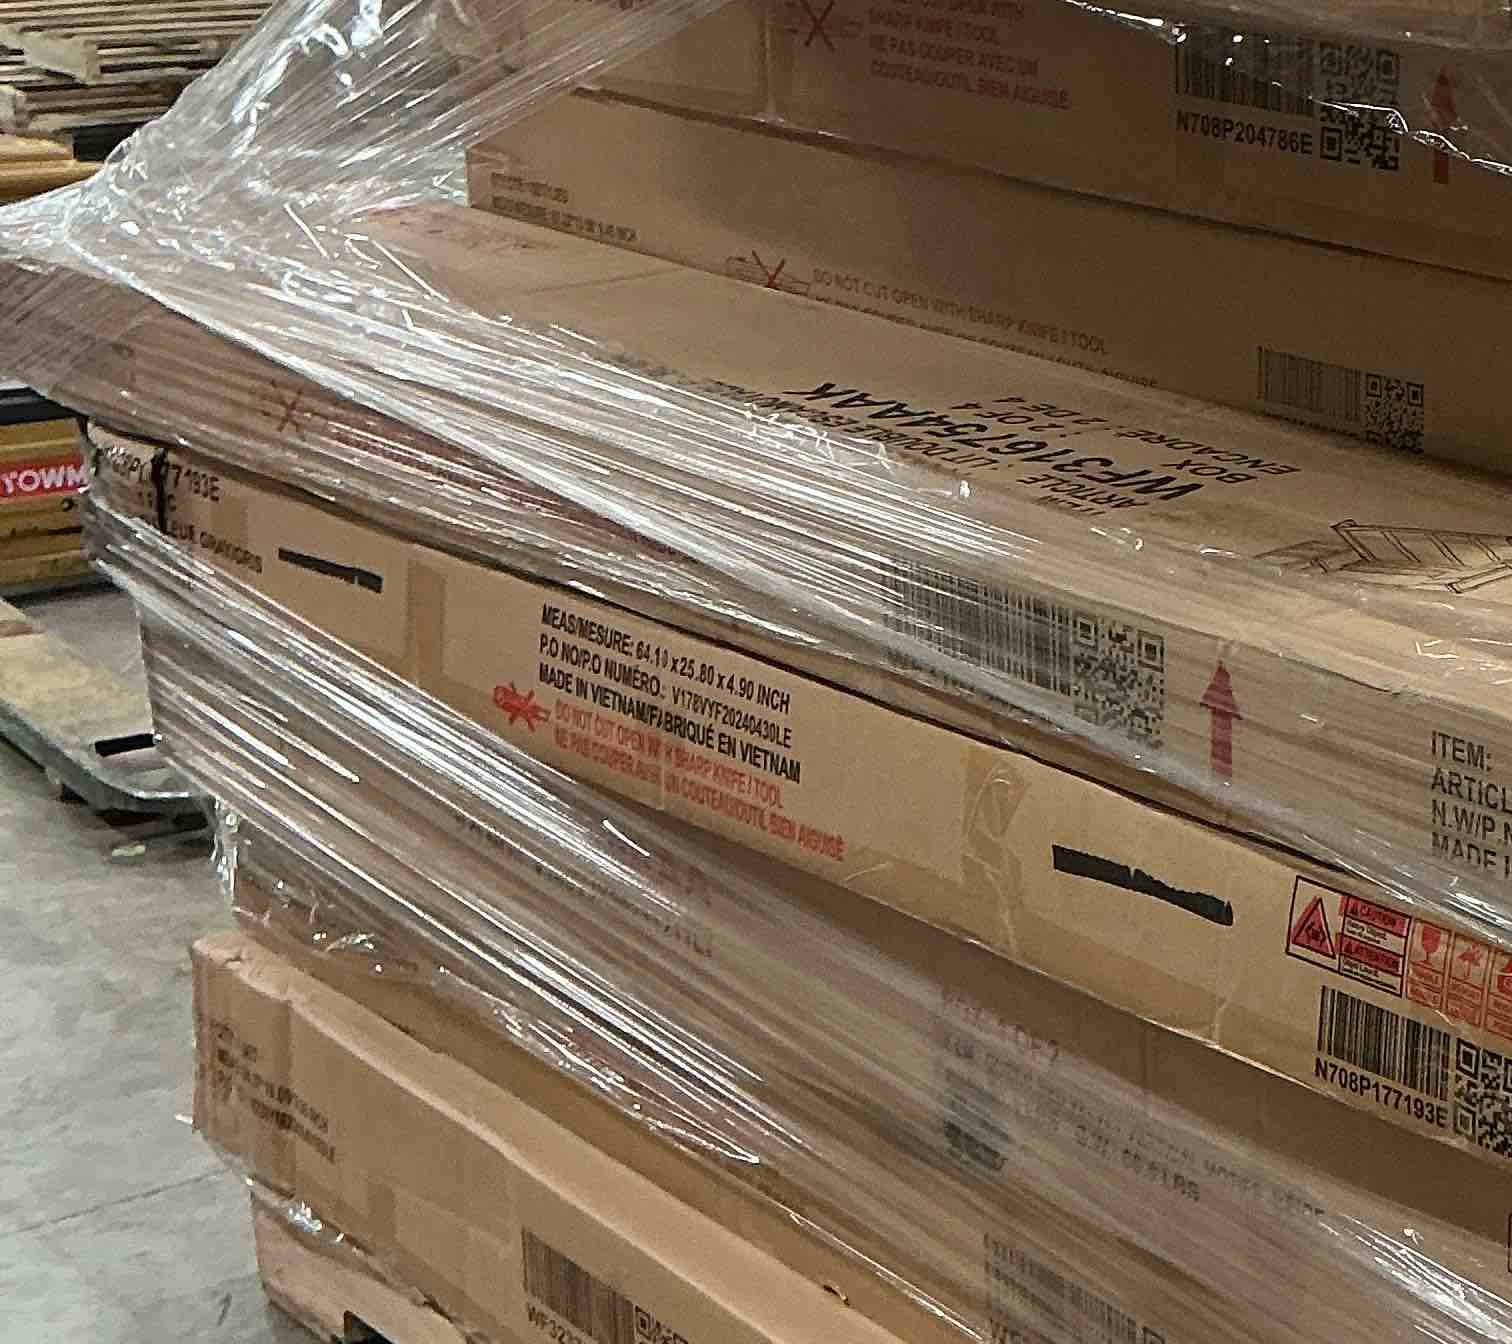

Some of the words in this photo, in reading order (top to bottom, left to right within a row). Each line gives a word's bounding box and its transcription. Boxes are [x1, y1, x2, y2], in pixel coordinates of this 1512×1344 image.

[1176, 110, 1313, 156] N708P204786E
[782, 381, 1204, 503] WF316754AAAK
[1018, 471, 1151, 508] ARTICLE
[1163, 456, 1258, 486] BOX
[539, 632, 559, 658] P.O
[757, 684, 791, 715] INCH
[539, 661, 573, 694] MADE
[575, 676, 588, 700] IN
[591, 682, 715, 749] VIETNAM/FABRIQUÉ
[717, 732, 737, 759] EN
[739, 739, 801, 785] VIETNAM
[1314, 1057, 1449, 1129] N708P177193E
